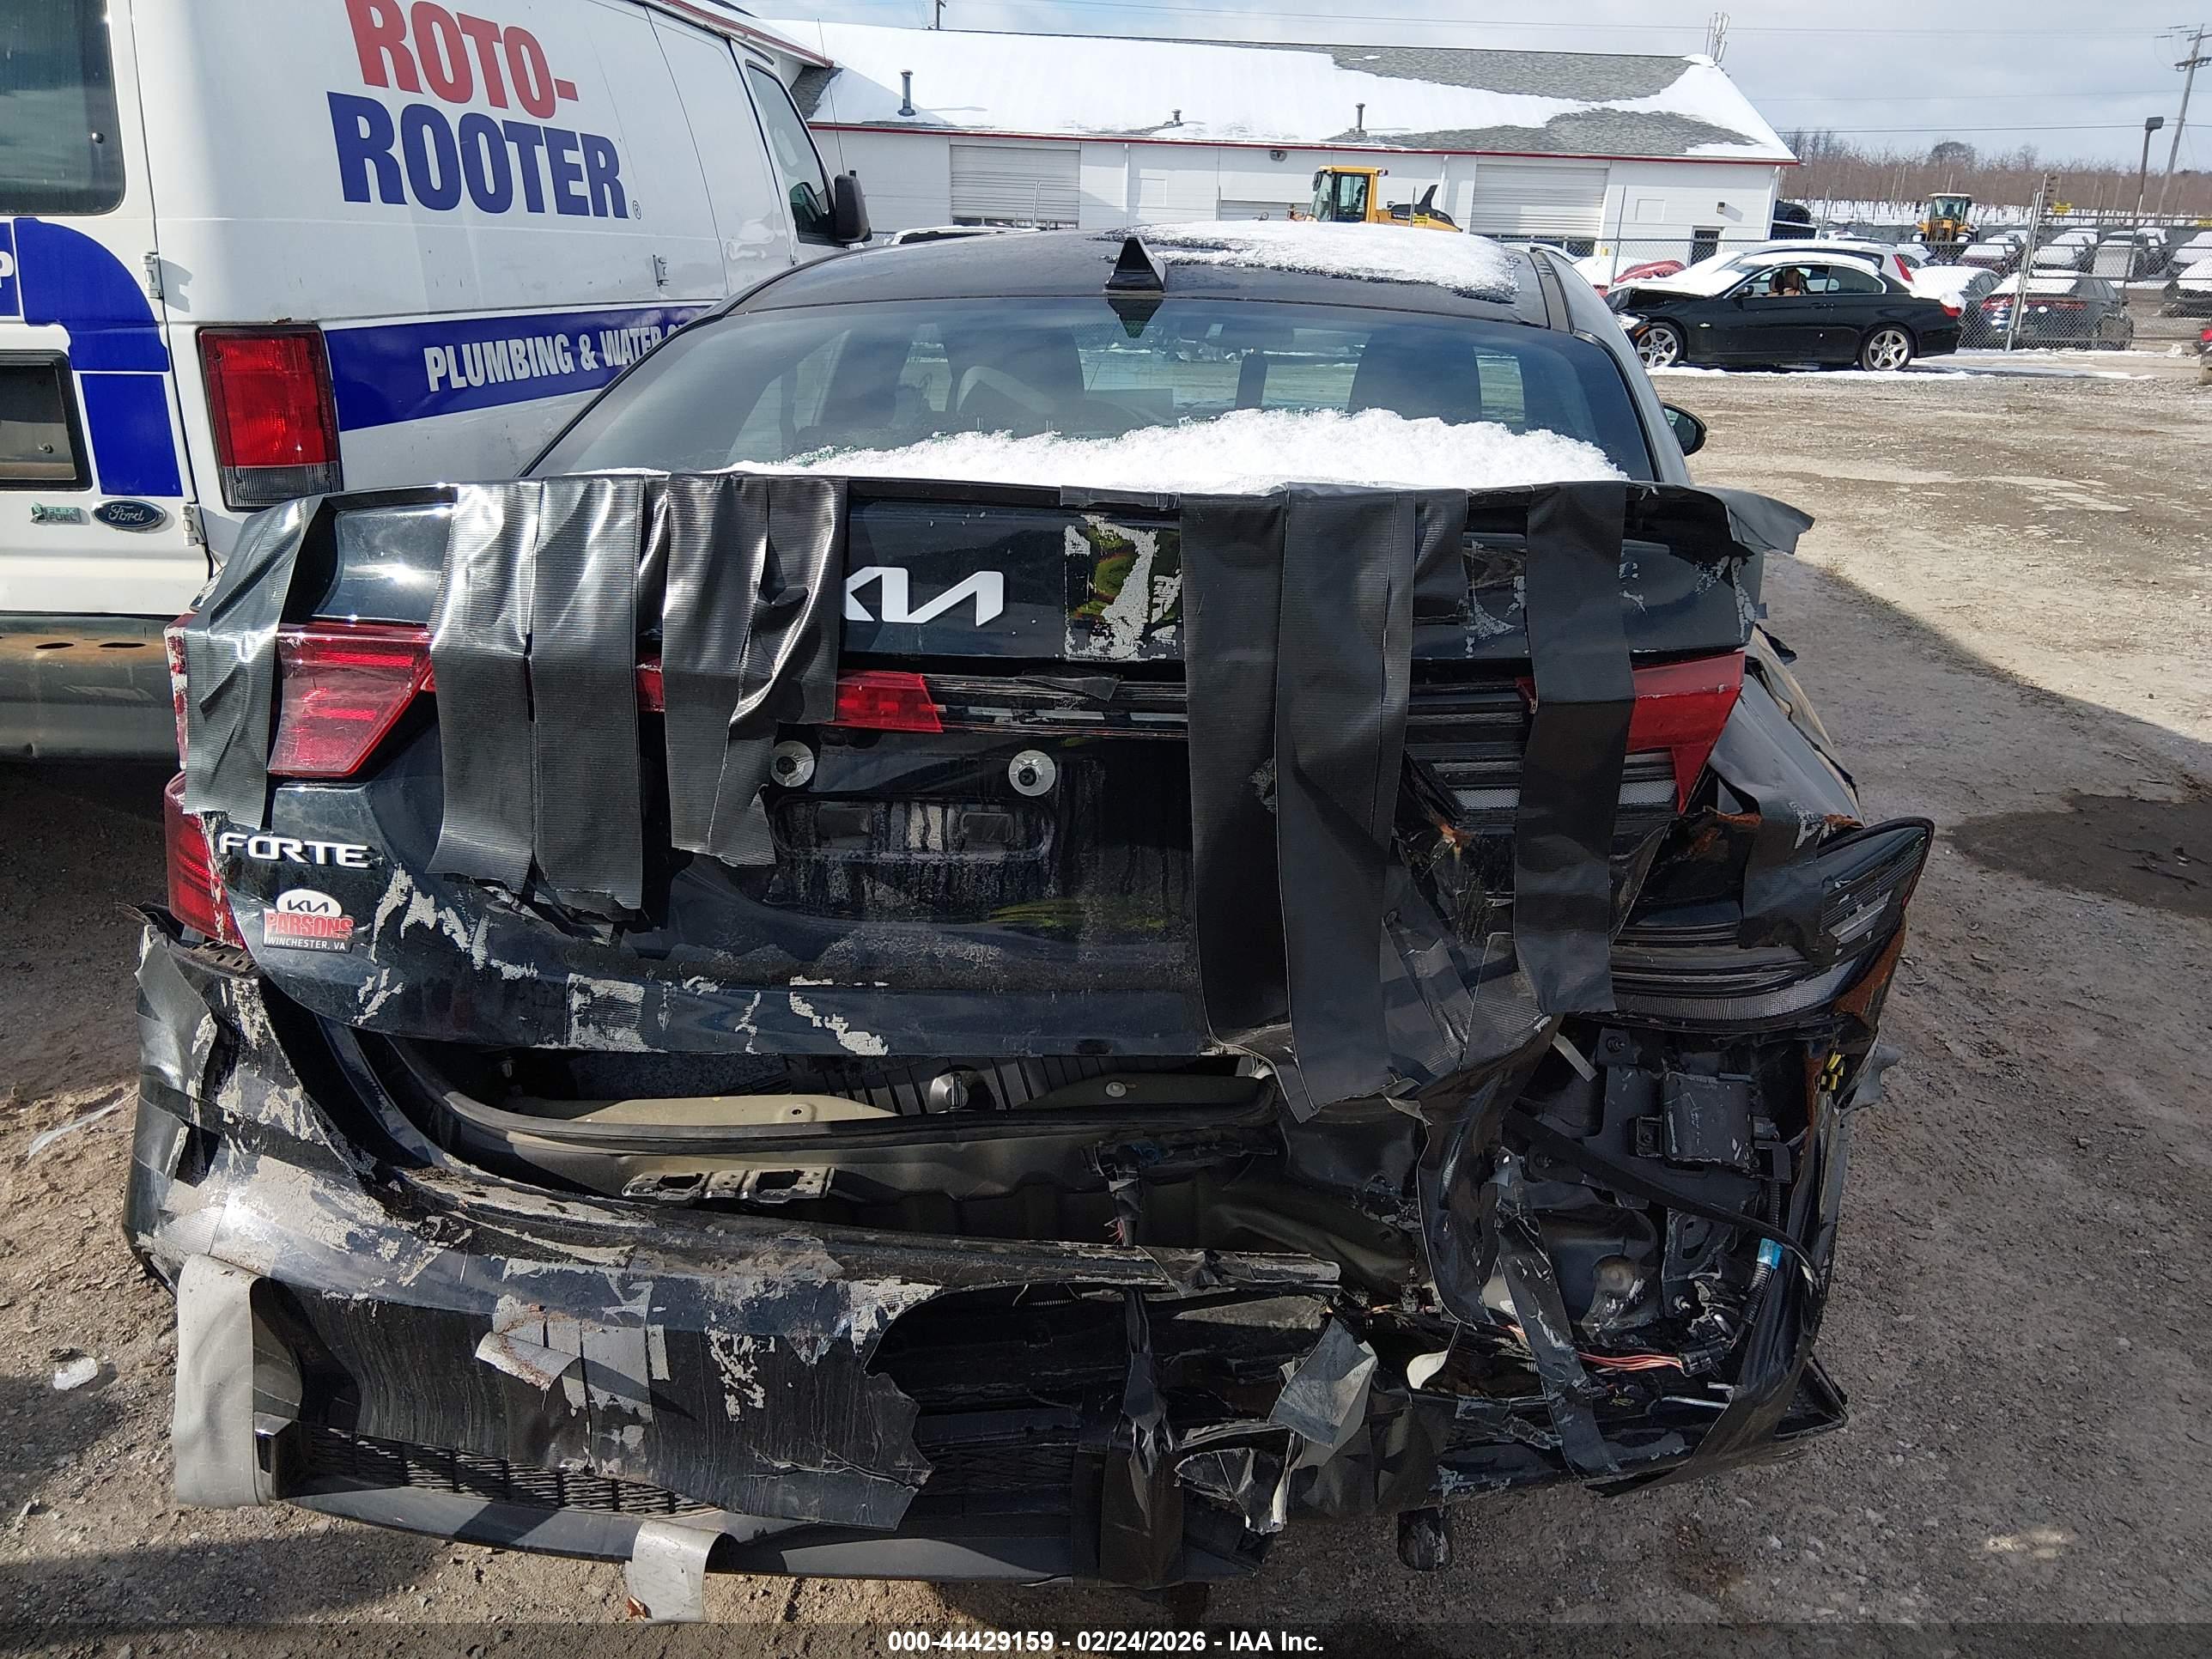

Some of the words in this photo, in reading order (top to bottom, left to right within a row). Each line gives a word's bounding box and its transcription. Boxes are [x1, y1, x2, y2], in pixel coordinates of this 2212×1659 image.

[345, 0, 579, 118] ROTO-
[326, 91, 629, 219] ROOTER
[423, 333, 575, 392] PLUMBING
[578, 334, 599, 371] &
[47, 507, 76, 515] FLEX
[108, 504, 145, 522] Ford
[219, 832, 370, 868] FORTE
[287, 899, 330, 914] KIA
[265, 911, 353, 939] PARSONS
[268, 935, 331, 950] WINCHESTER,
[333, 941, 345, 951] VA
